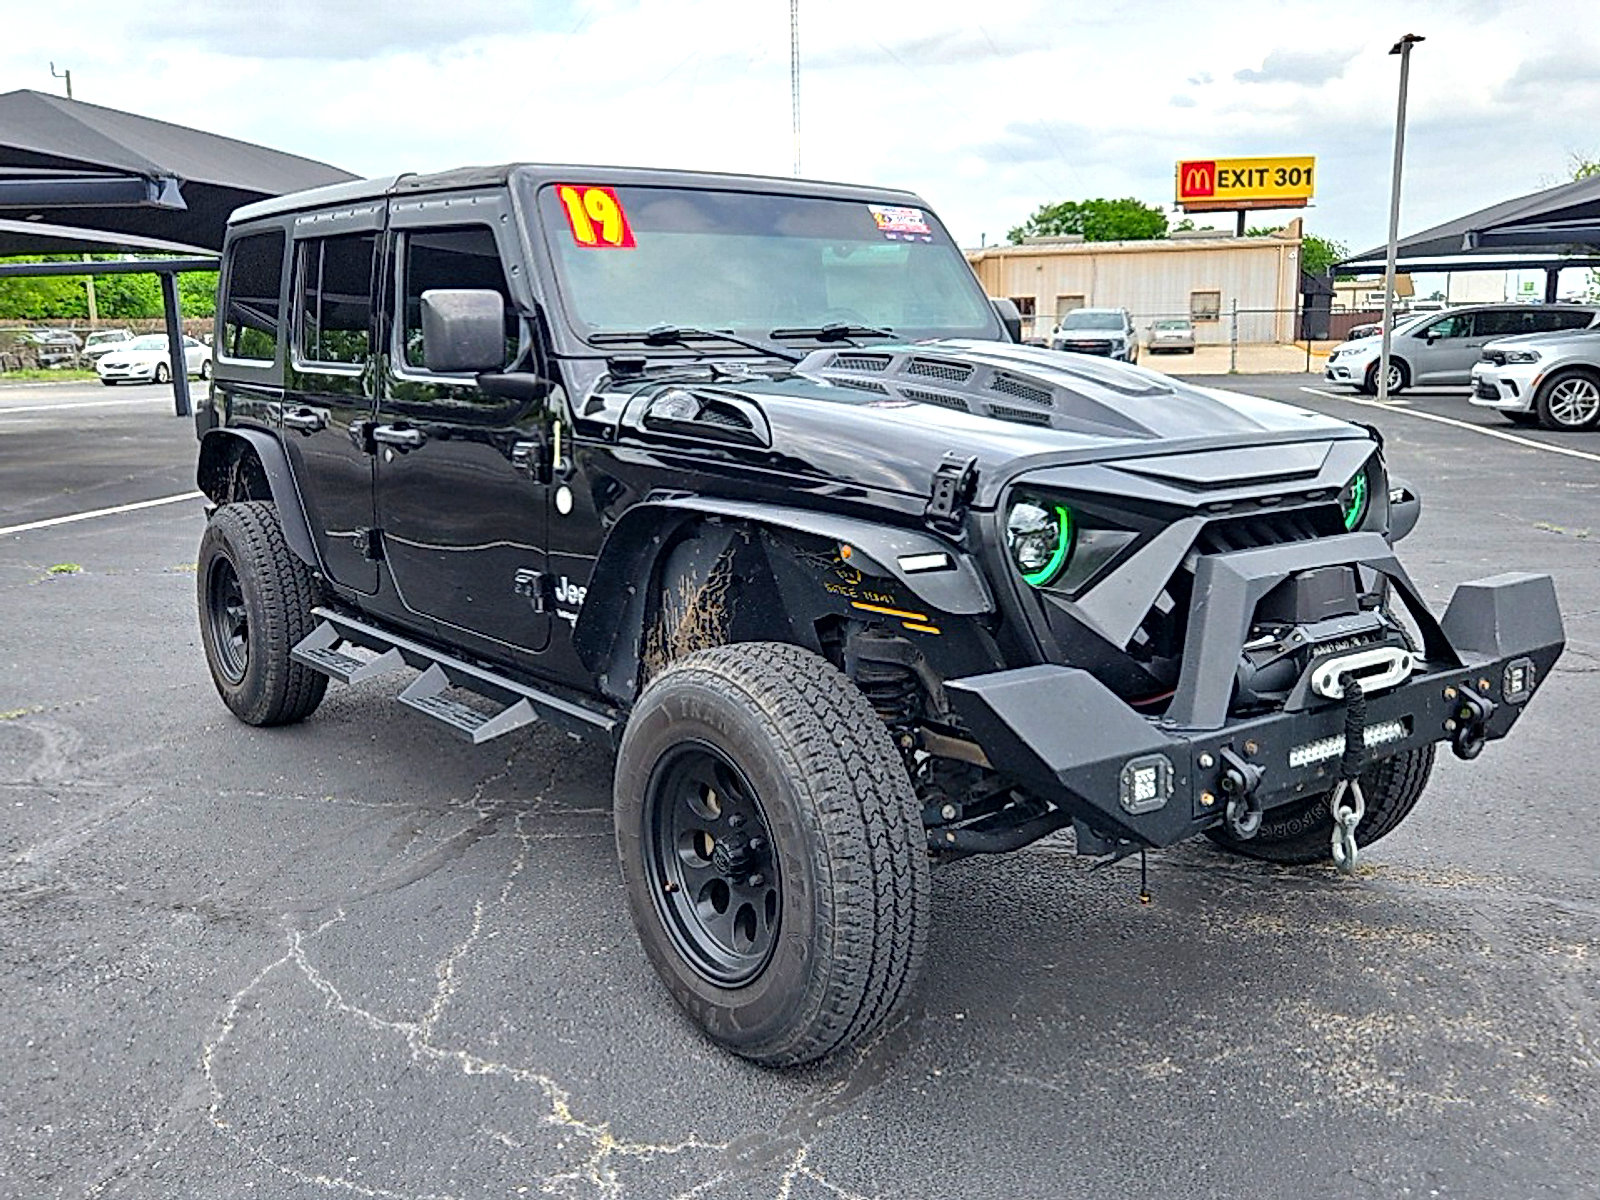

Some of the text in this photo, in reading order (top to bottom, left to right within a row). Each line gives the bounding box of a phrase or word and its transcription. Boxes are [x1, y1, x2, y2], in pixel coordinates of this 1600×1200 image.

[1217, 167, 1312, 188] EXIT 301
[561, 187, 622, 246] 19
[554, 576, 588, 605] Jee
